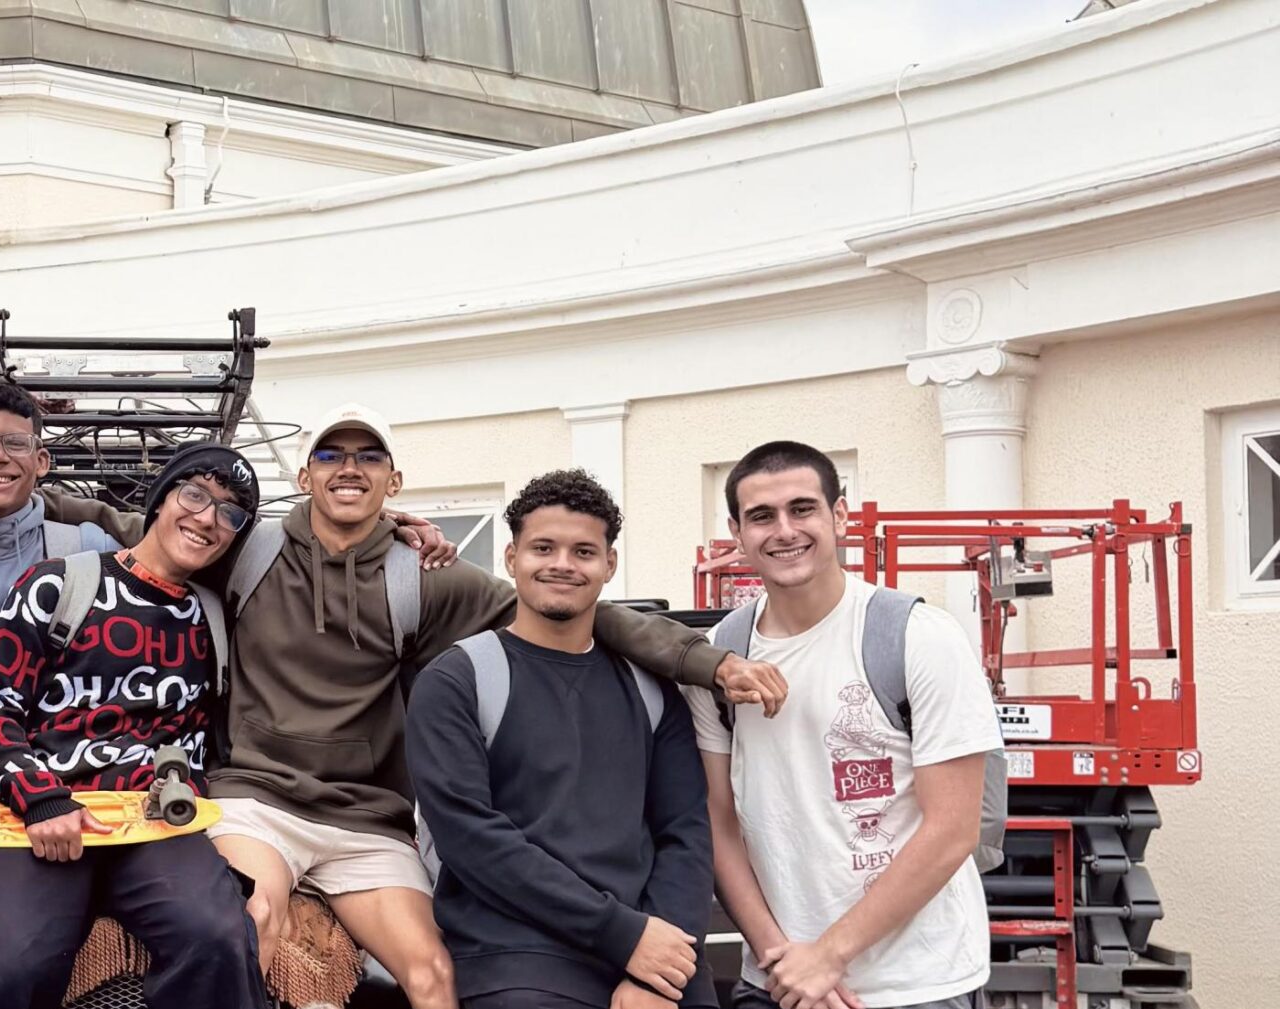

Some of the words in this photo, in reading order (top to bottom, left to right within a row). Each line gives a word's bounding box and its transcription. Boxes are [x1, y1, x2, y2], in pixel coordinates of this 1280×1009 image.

[846, 763, 879, 777] ONE
[840, 773, 890, 797] PIECE
[852, 849, 894, 871] LUFFY
